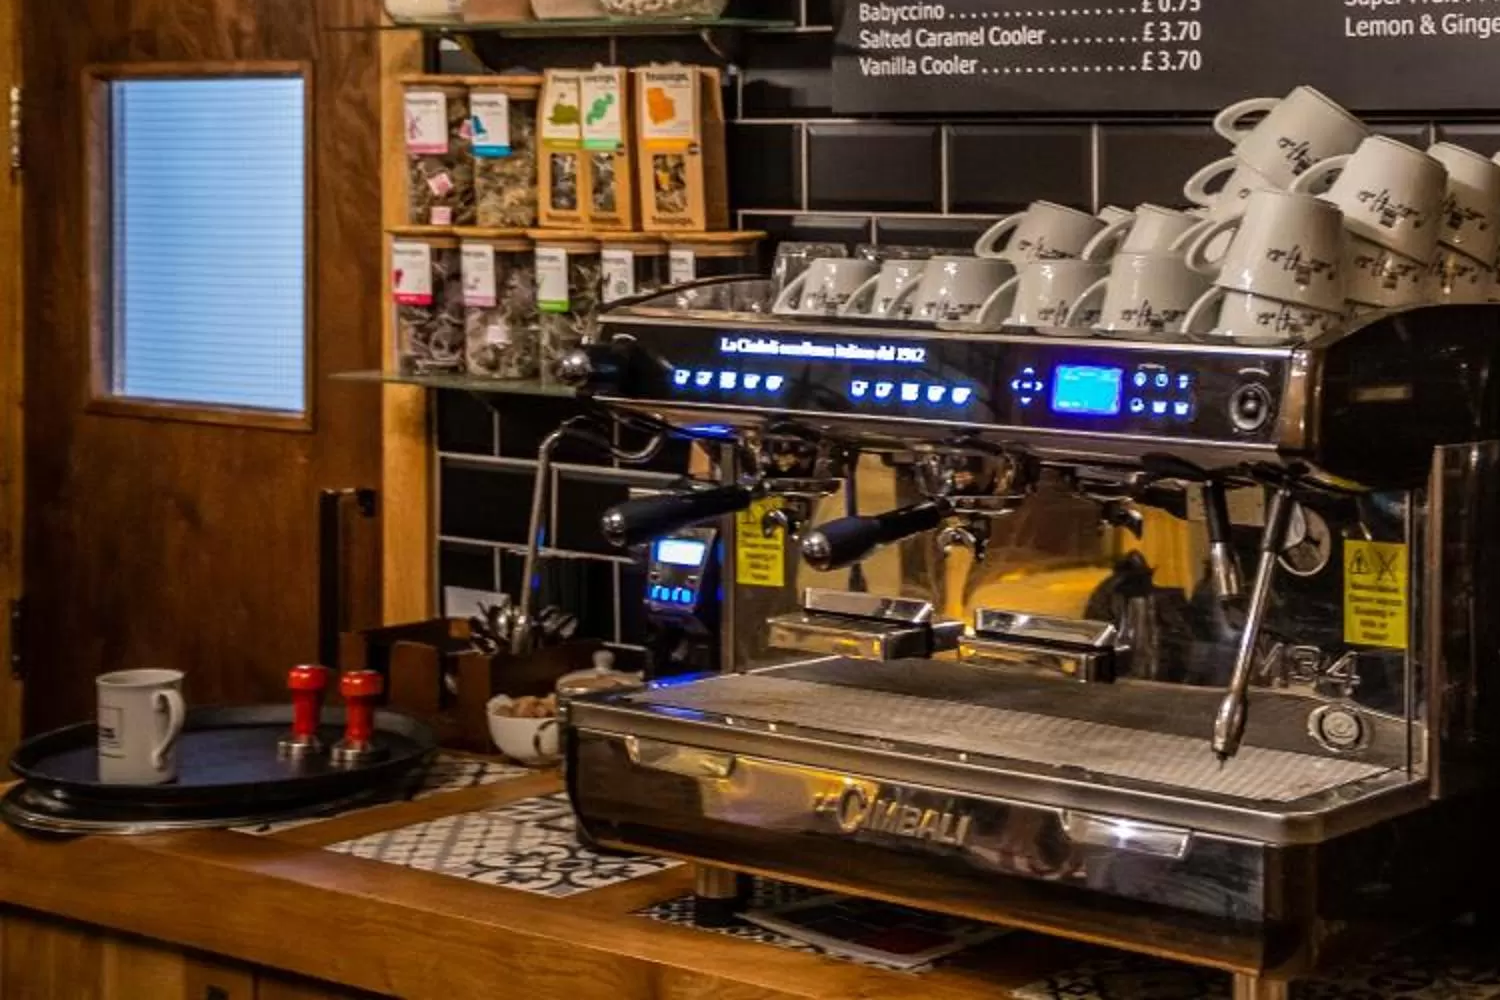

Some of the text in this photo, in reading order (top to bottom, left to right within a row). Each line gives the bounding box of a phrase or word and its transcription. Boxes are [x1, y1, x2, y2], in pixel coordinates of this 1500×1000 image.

[858, 1, 946, 25] Babyccino
[858, 28, 912, 50] Salted
[914, 25, 986, 48] Caramel
[987, 24, 1047, 47] Cooler
[1344, 15, 1415, 38] Lemon
[1418, 13, 1438, 36] &
[858, 56, 918, 77] Vanilla
[919, 54, 980, 76] Cooler
